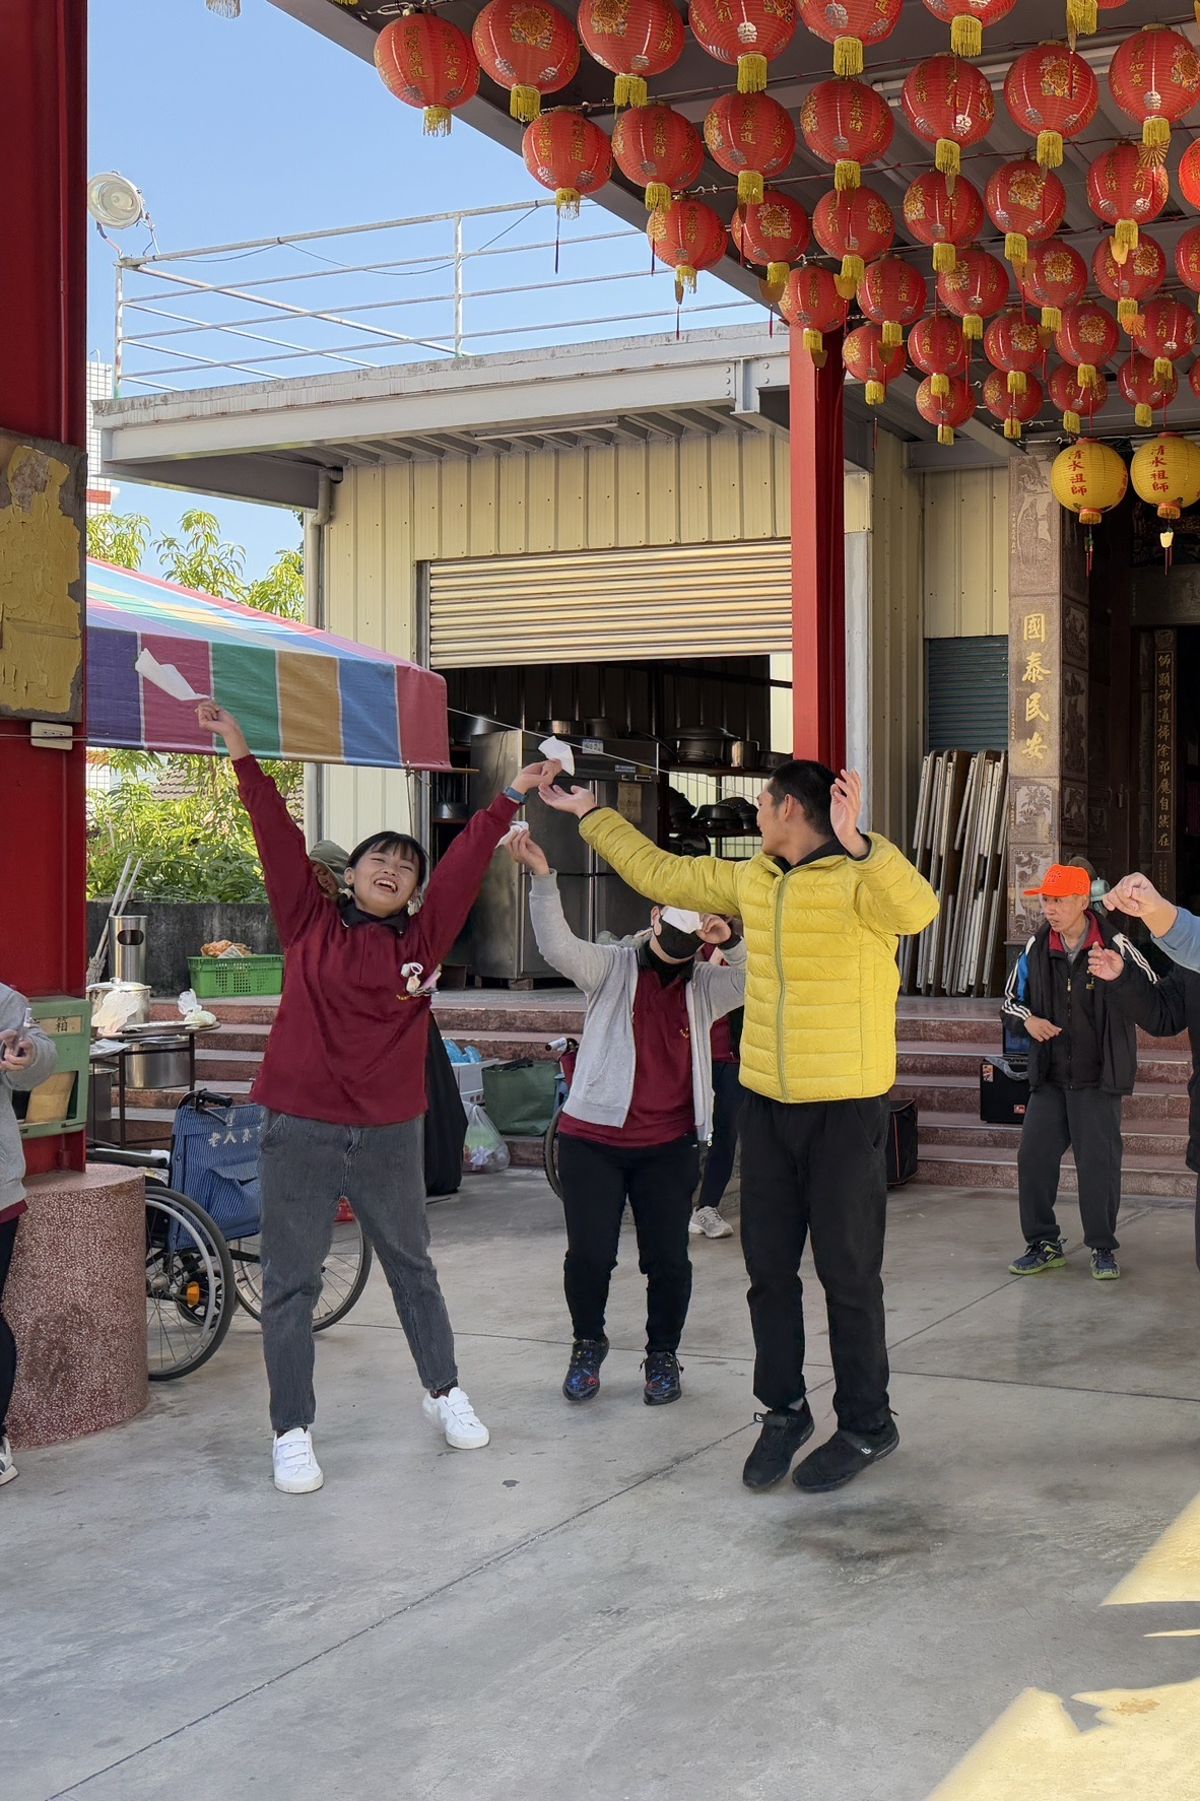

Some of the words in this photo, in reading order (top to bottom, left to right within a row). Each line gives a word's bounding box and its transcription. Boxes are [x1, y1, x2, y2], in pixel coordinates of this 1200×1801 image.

[1068, 450, 1087, 496] 清水祖師
[1150, 445, 1169, 492] 清水祖師
[1022, 613, 1052, 760] 國泰民安
